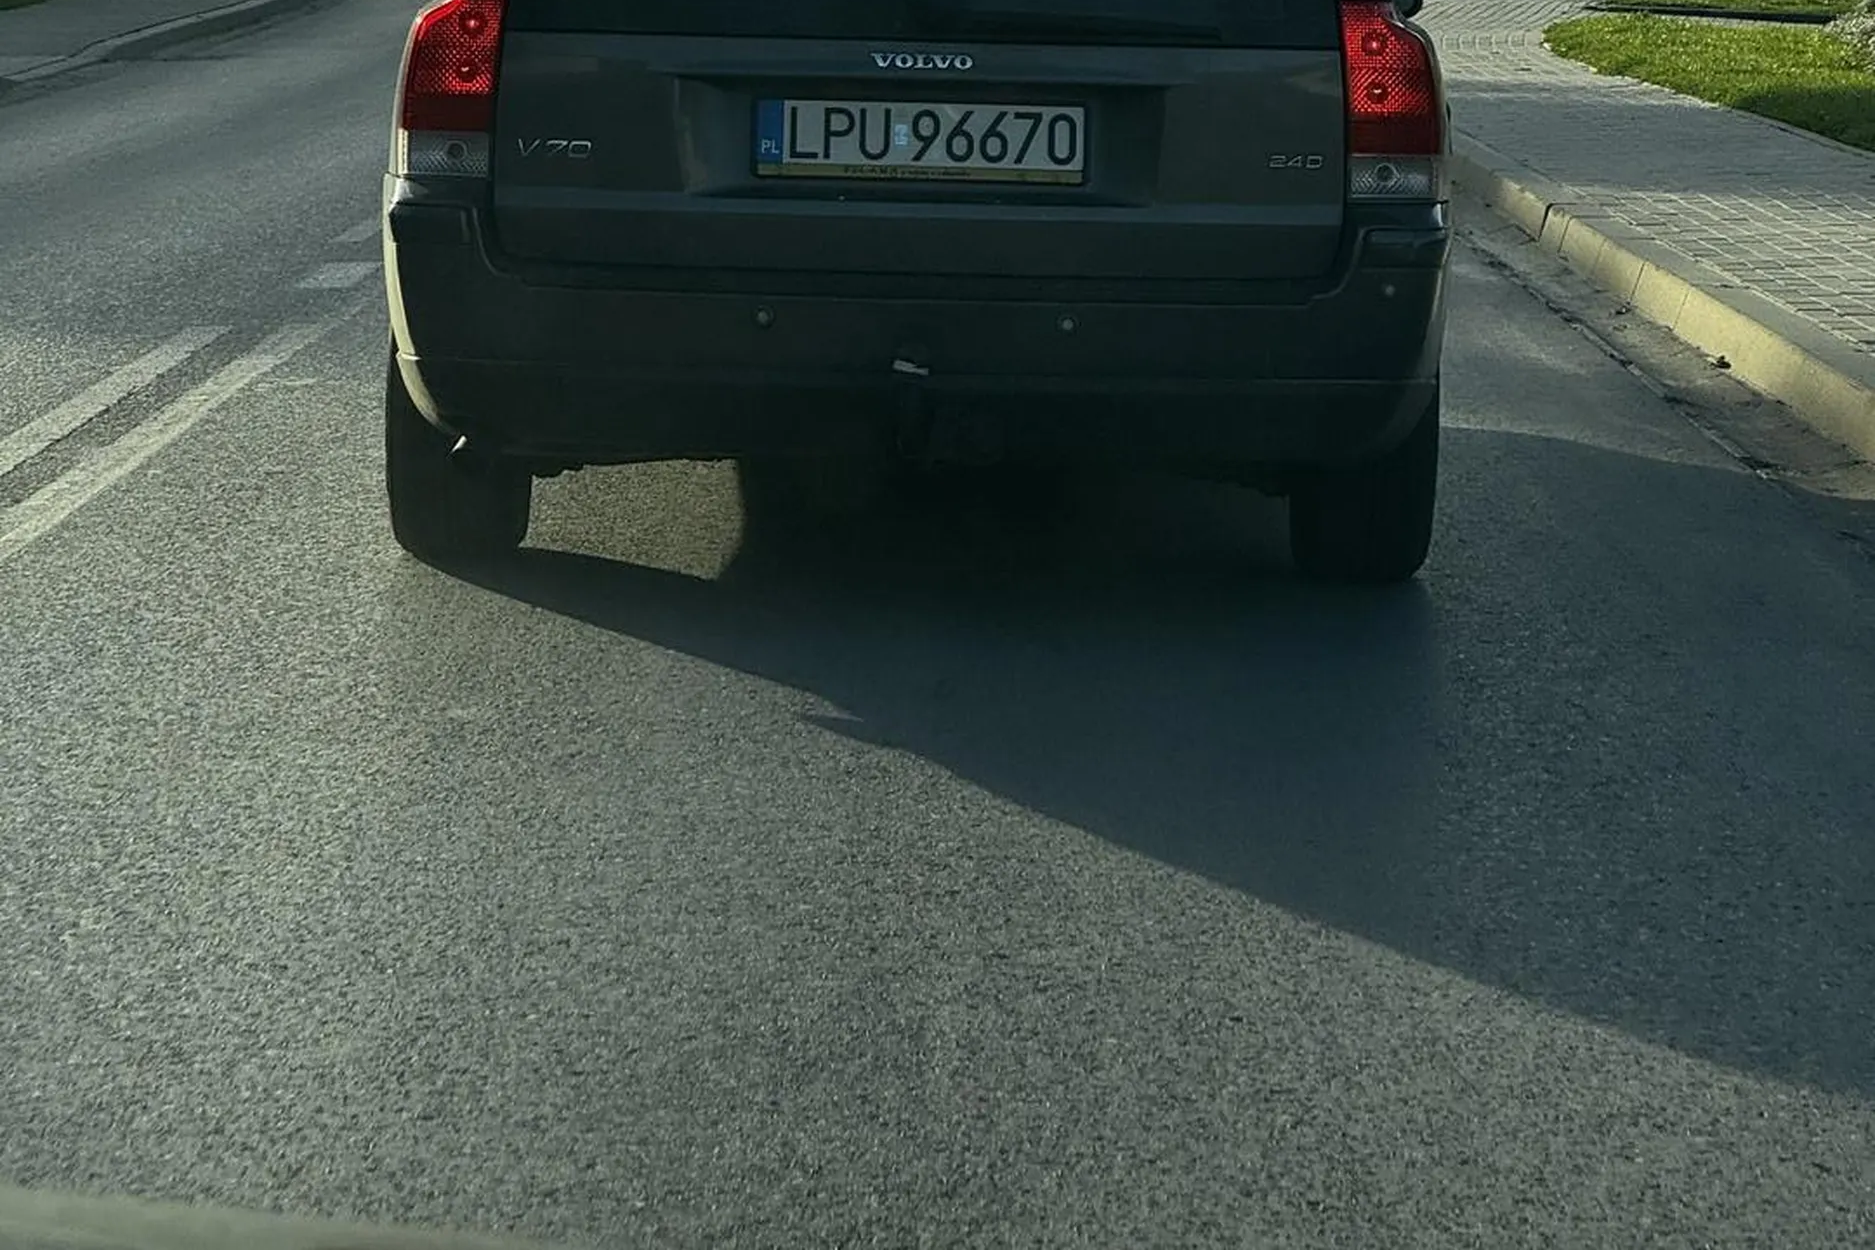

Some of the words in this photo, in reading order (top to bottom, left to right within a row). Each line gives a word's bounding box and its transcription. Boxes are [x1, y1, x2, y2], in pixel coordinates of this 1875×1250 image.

[871, 53, 974, 70] VOLVO
[761, 138, 780, 154] PL
[789, 105, 892, 161] LPU
[911, 108, 1078, 166] 96670
[517, 138, 592, 157] V70
